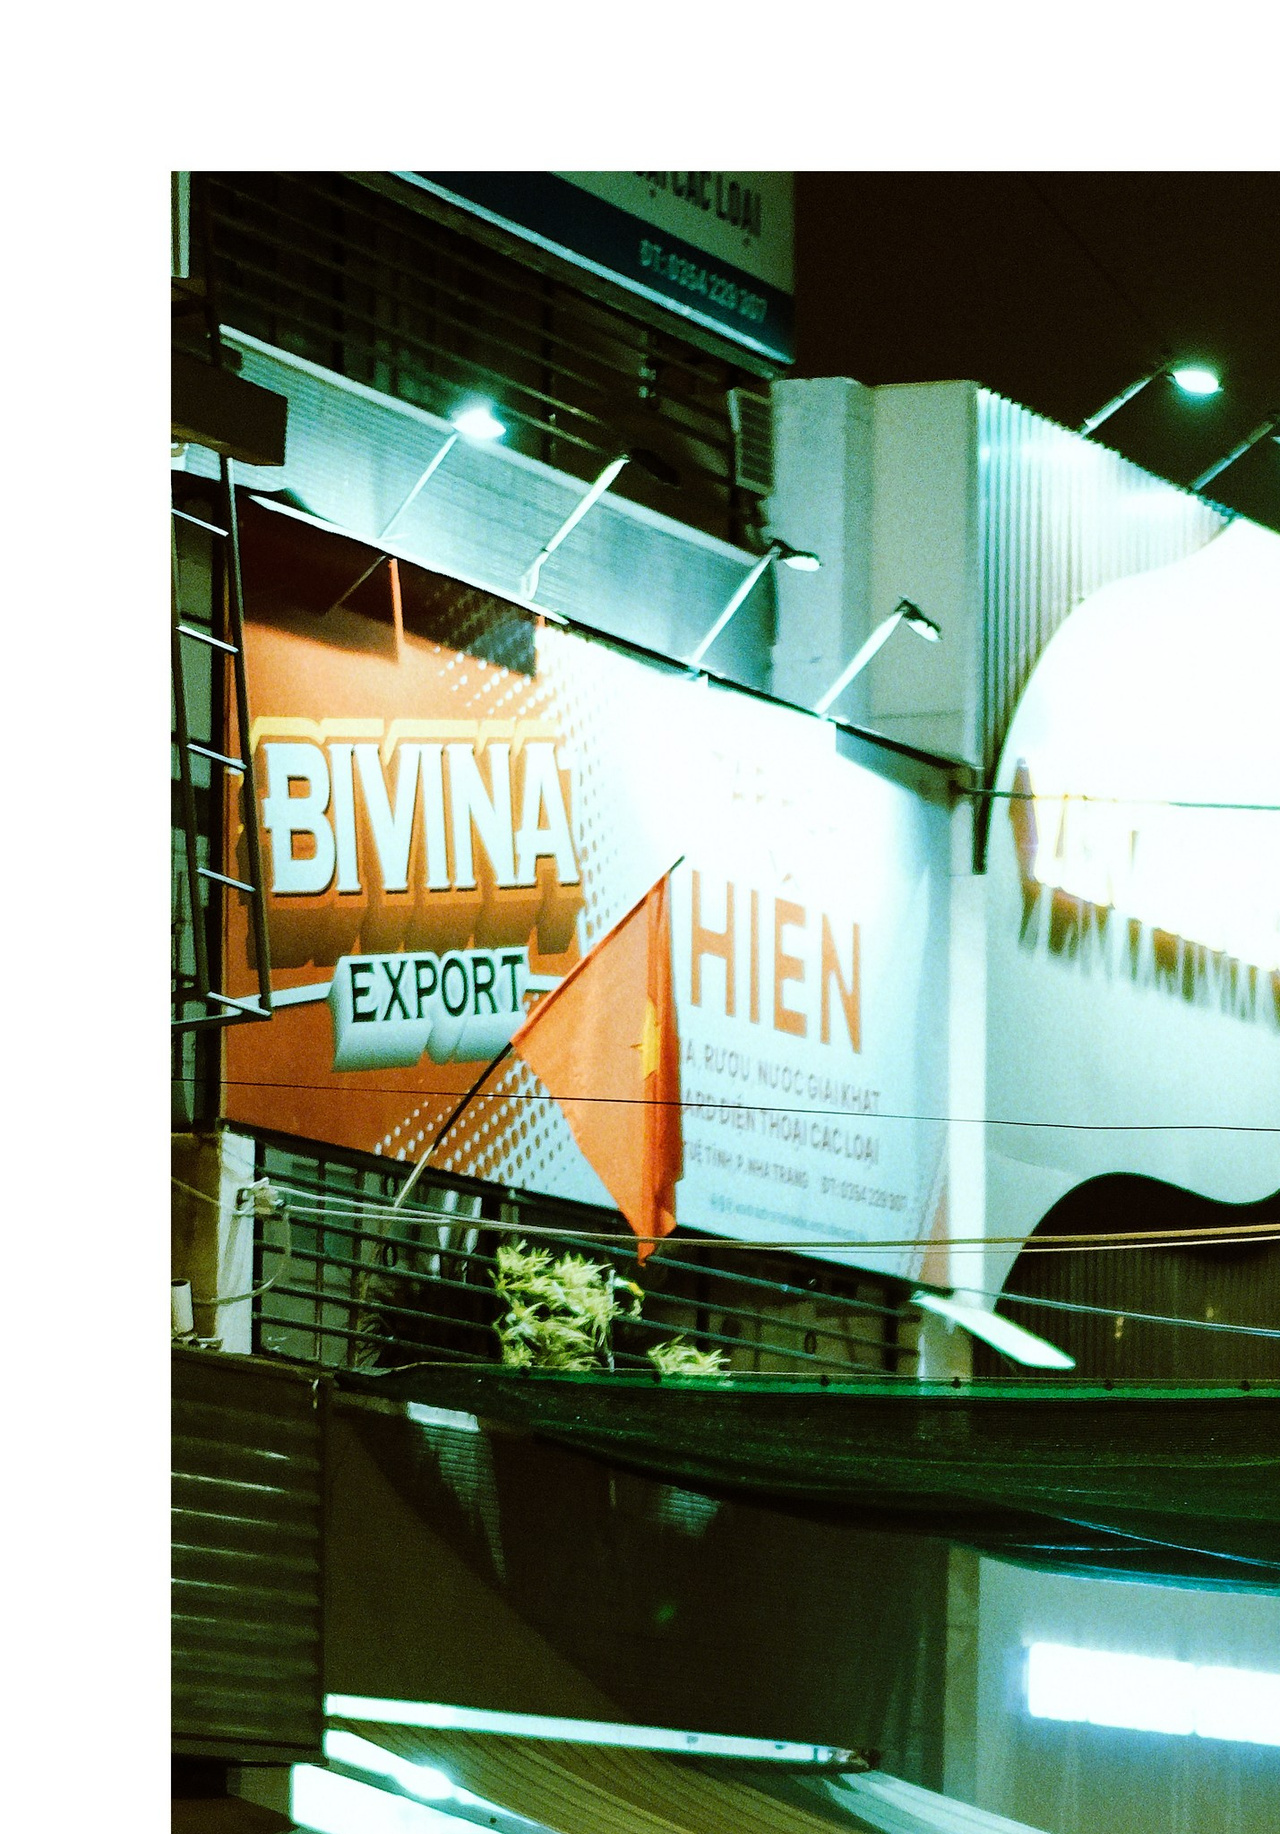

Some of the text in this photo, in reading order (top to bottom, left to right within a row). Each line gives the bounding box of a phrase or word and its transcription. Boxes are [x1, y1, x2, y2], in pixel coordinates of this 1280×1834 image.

[262, 740, 581, 898] BIVINA
[350, 952, 526, 1024] EXPORT
[682, 1086, 716, 1122] ARD
